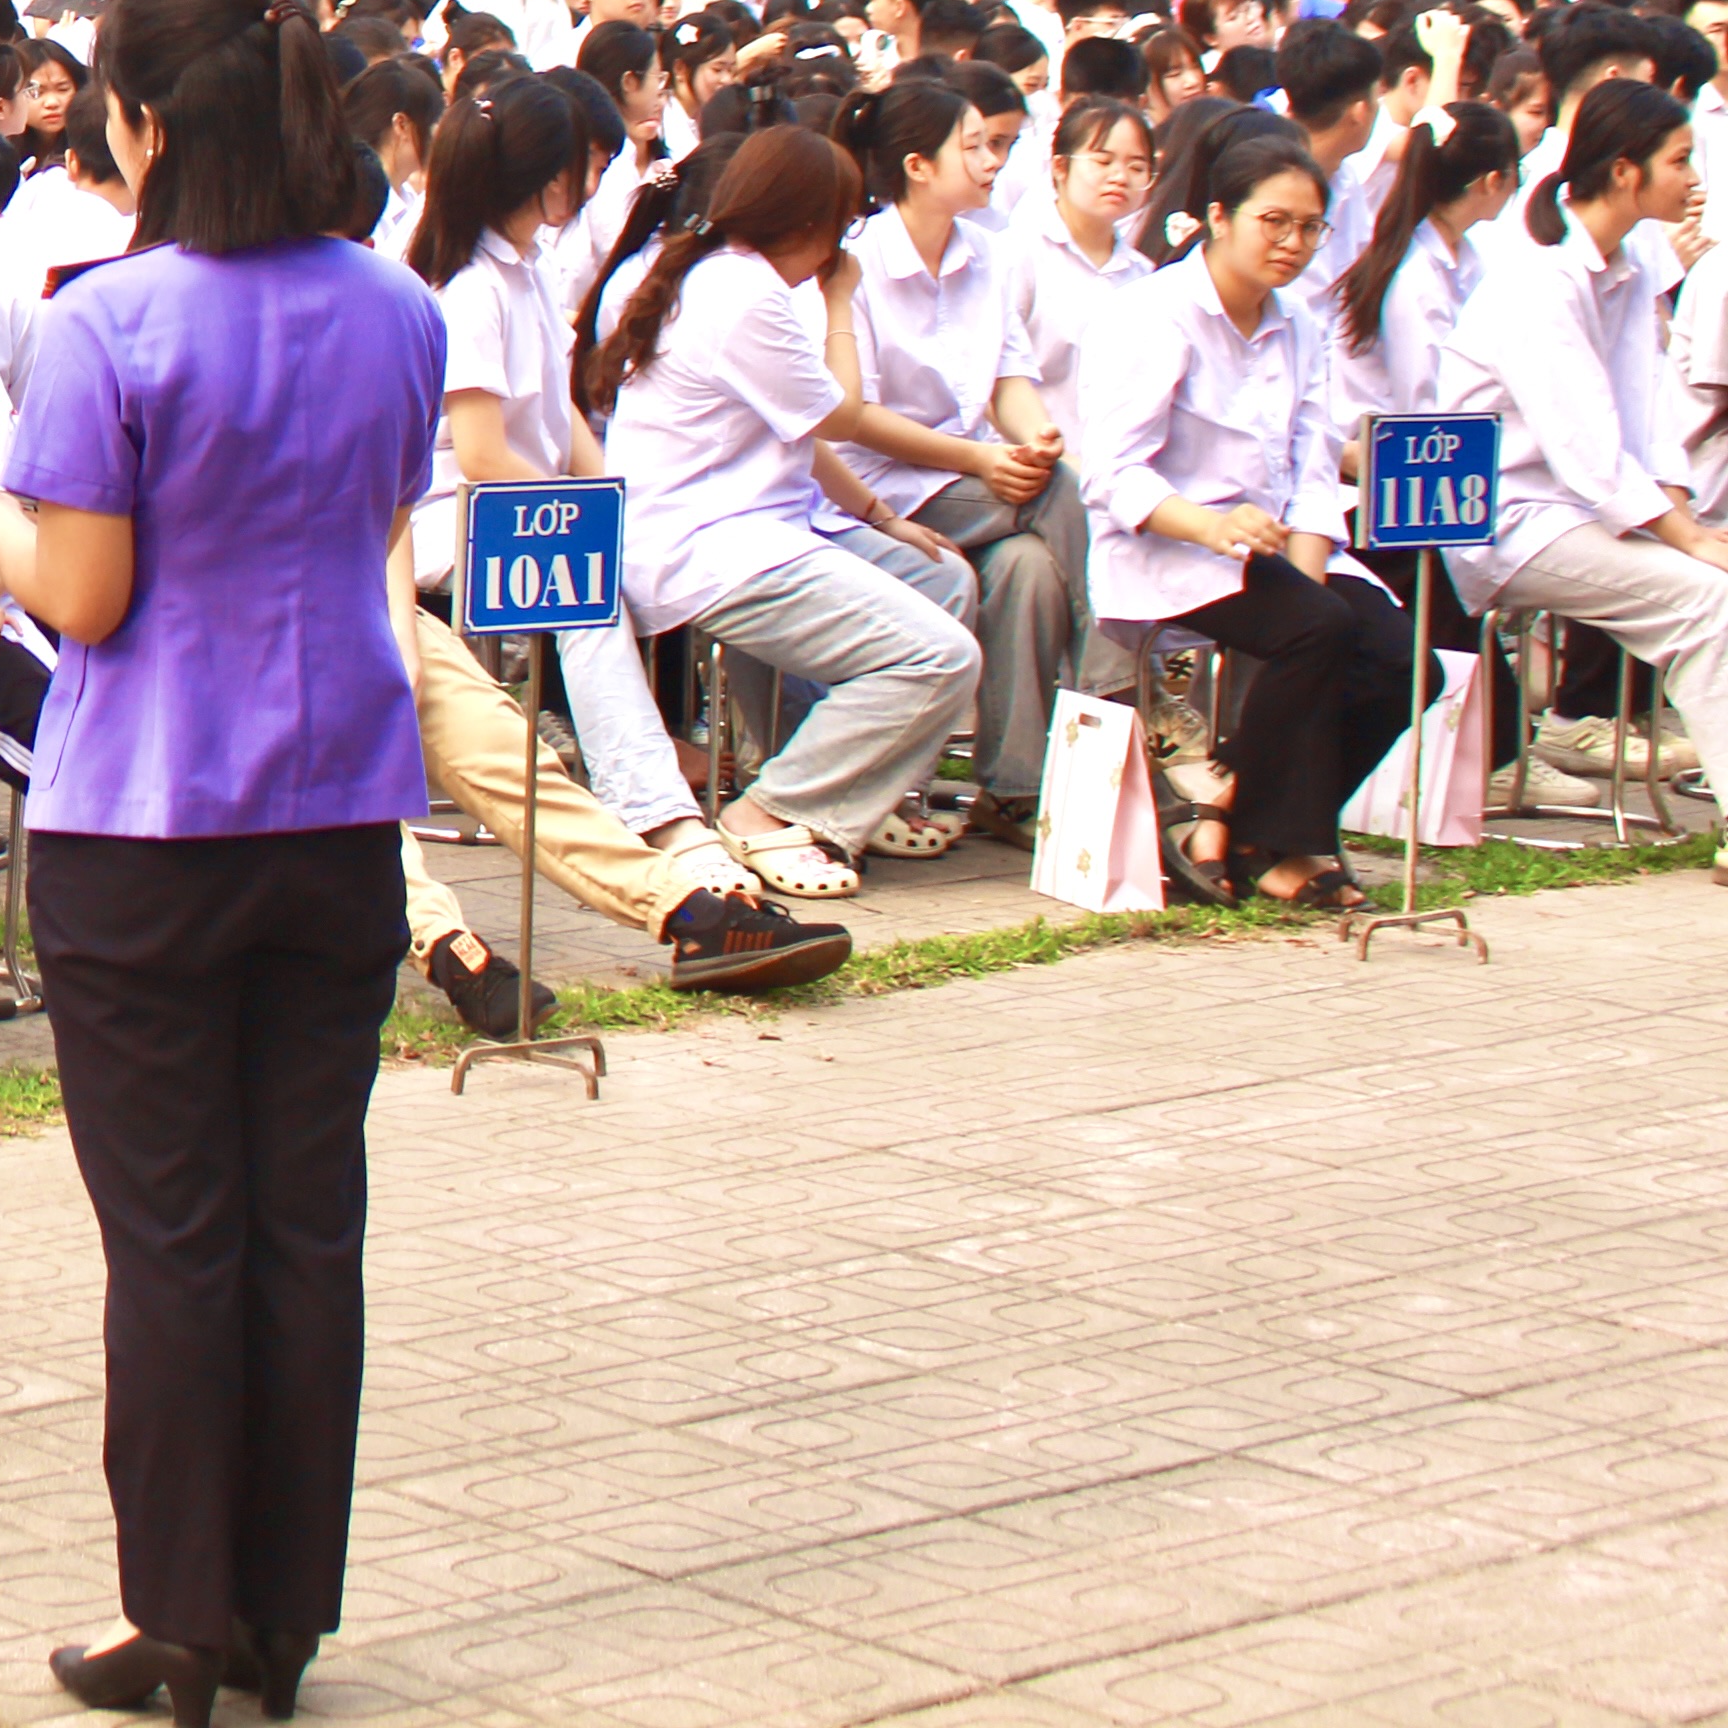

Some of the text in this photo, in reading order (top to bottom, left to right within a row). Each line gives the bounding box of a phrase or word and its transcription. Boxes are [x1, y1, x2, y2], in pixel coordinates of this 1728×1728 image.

[1404, 425, 1462, 465] LỚP
[1378, 474, 1488, 528] 11A8
[486, 552, 606, 609] 10A1
